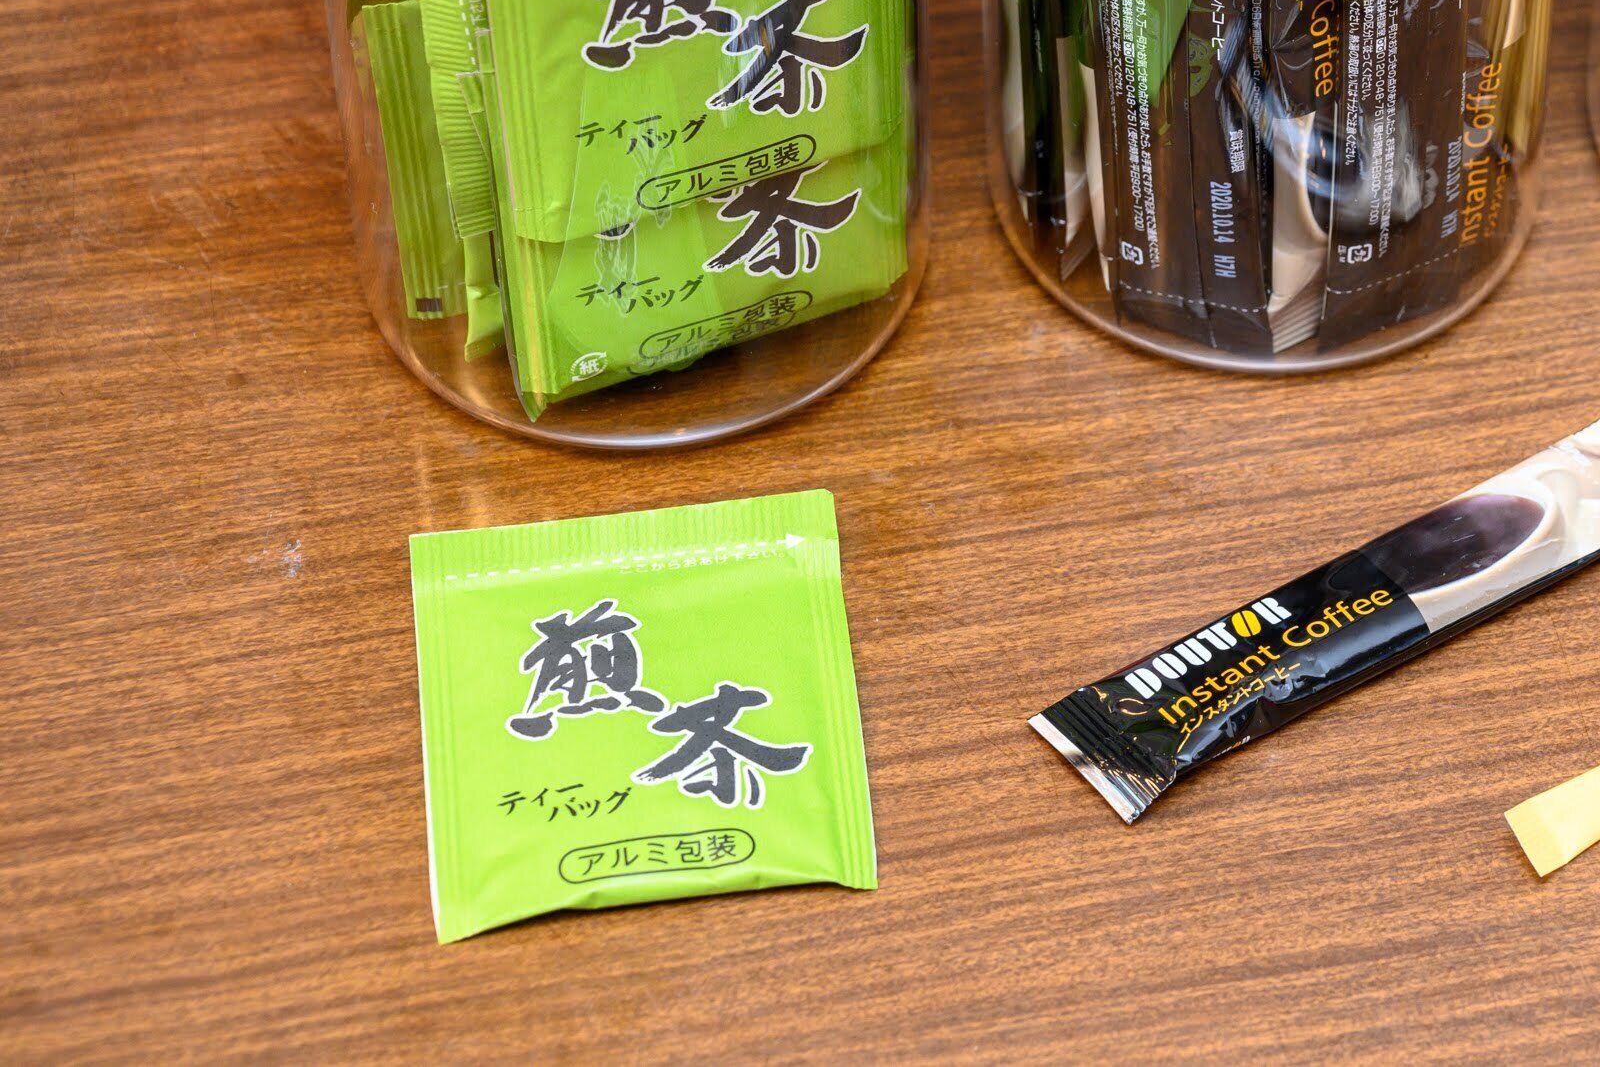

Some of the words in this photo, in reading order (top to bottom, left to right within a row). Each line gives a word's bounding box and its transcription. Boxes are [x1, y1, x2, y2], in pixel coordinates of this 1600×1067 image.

[1309, 0, 1335, 97] Coffee
[656, 140, 802, 204] アルミ包装
[1229, 130, 1246, 173] 賞味期限
[1210, 181, 1235, 243] 2020.10.14
[1125, 597, 1292, 699] DOUTOR
[1157, 645, 1281, 725] Instant
[1281, 587, 1394, 648] Coffee
[505, 598, 814, 811] 煎茶
[1179, 663, 1302, 742] インスタントコーヒー
[577, 834, 738, 877] アルミ包装
